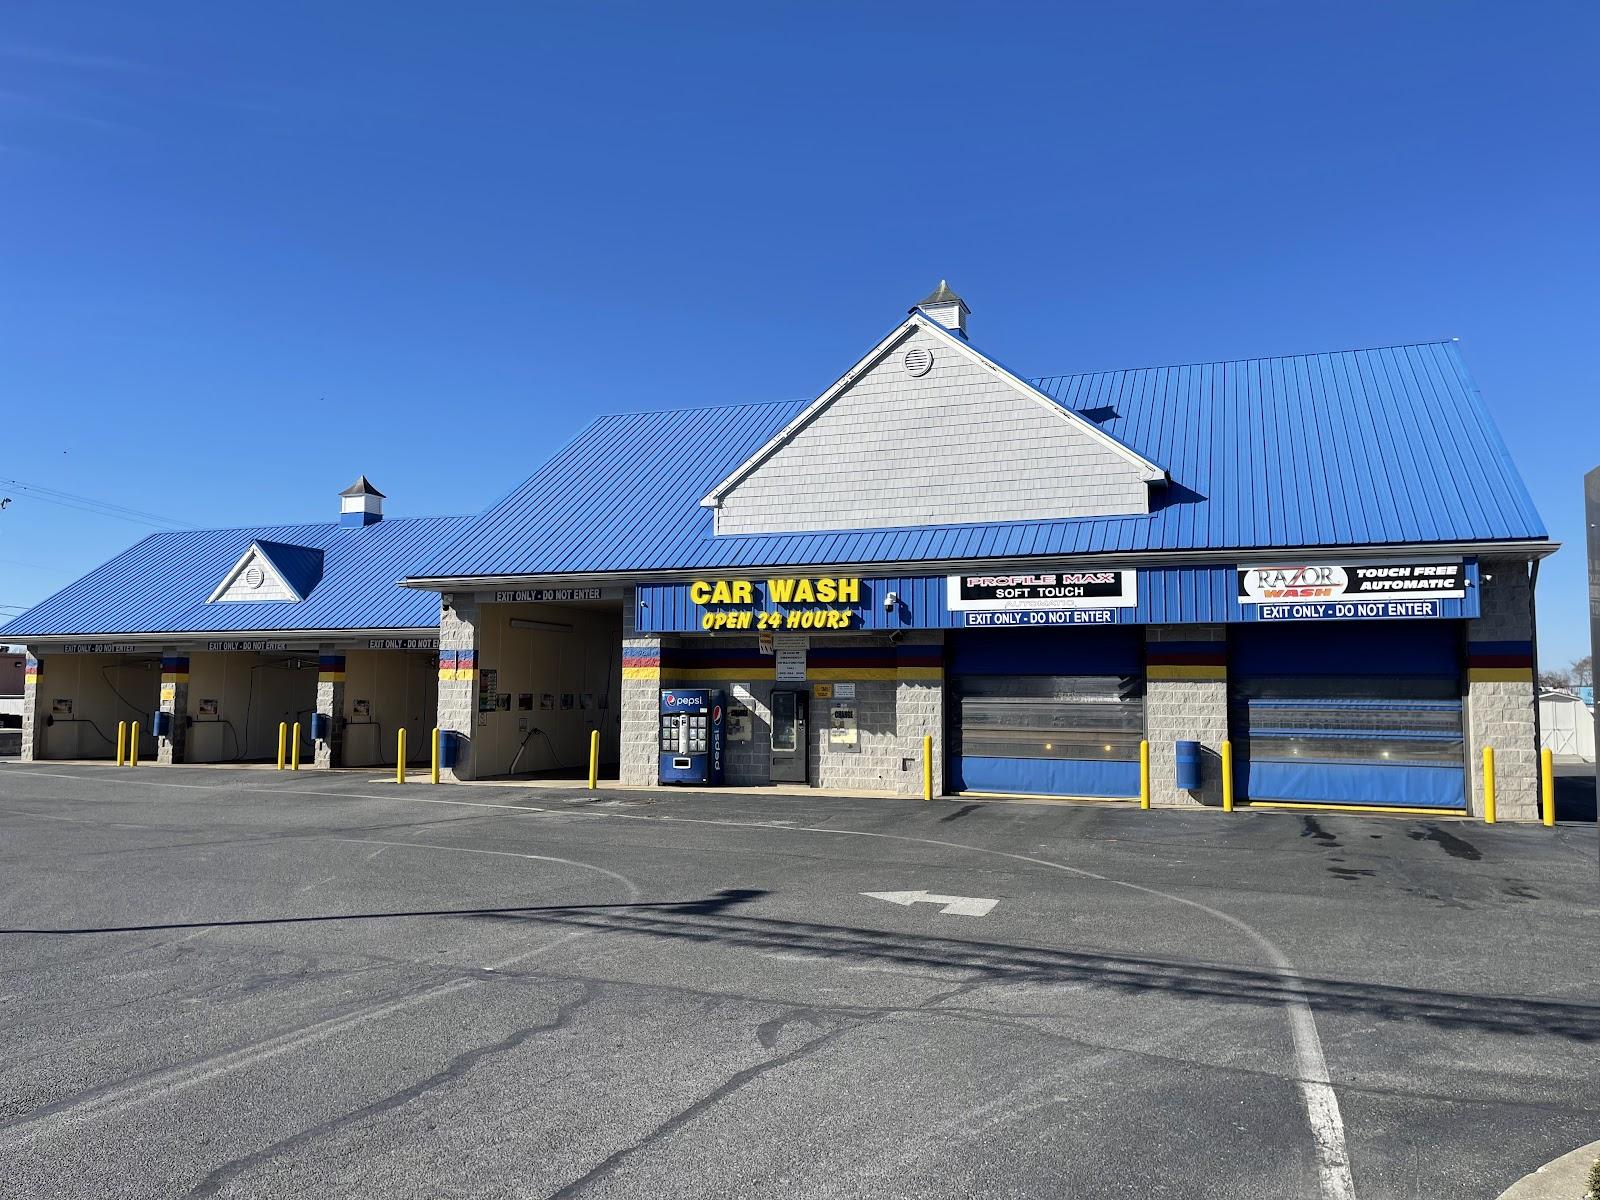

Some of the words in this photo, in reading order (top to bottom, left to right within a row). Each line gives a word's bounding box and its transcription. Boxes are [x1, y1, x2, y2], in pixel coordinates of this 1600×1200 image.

[1253, 566, 1343, 588] RAZOR
[1356, 568, 1410, 578] TOUCH
[1413, 566, 1458, 577] FREE
[967, 574, 1057, 587] PROFILE
[1062, 573, 1115, 585] MAX
[1359, 579, 1455, 591] AUTOMATIC
[497, 591, 514, 602] EXIT
[516, 590, 536, 601] ONLY
[542, 590, 554, 600] DO
[555, 589, 572, 600] NOT
[573, 589, 600, 599] ENTER
[690, 580, 753, 604] CAR
[767, 578, 859, 603] WASH
[996, 588, 1031, 598] SOFT
[1037, 587, 1084, 597] TOUCH
[1263, 588, 1333, 598] WASH
[1263, 605, 1290, 618] EXIT
[1293, 605, 1326, 617] ONLY
[1335, 604, 1354, 616] DO
[1357, 603, 1386, 616] NOT
[1388, 603, 1432, 616] ENTER
[702, 611, 753, 629] OPEN
[756, 611, 783, 629] 24
[786, 610, 852, 629] HOURS
[969, 613, 992, 625] EXIT
[994, 612, 1022, 624] ONLY
[1030, 612, 1045, 623] DO
[1048, 611, 1072, 623] NOT
[1074, 610, 1111, 622] ENTER
[64, 644, 77, 652] EXIT
[77, 644, 92, 652] ONLY
[95, 644, 103, 652] DO
[209, 642, 222, 650] EXIT
[223, 642, 239, 650] ONLY
[243, 641, 252, 650] DO
[252, 641, 265, 650] NOT
[370, 640, 385, 648] EXIT
[385, 640, 403, 648] ONLY
[407, 640, 417, 648] DO
[417, 640, 432, 648] NOT
[677, 696, 702, 706] pepsi
